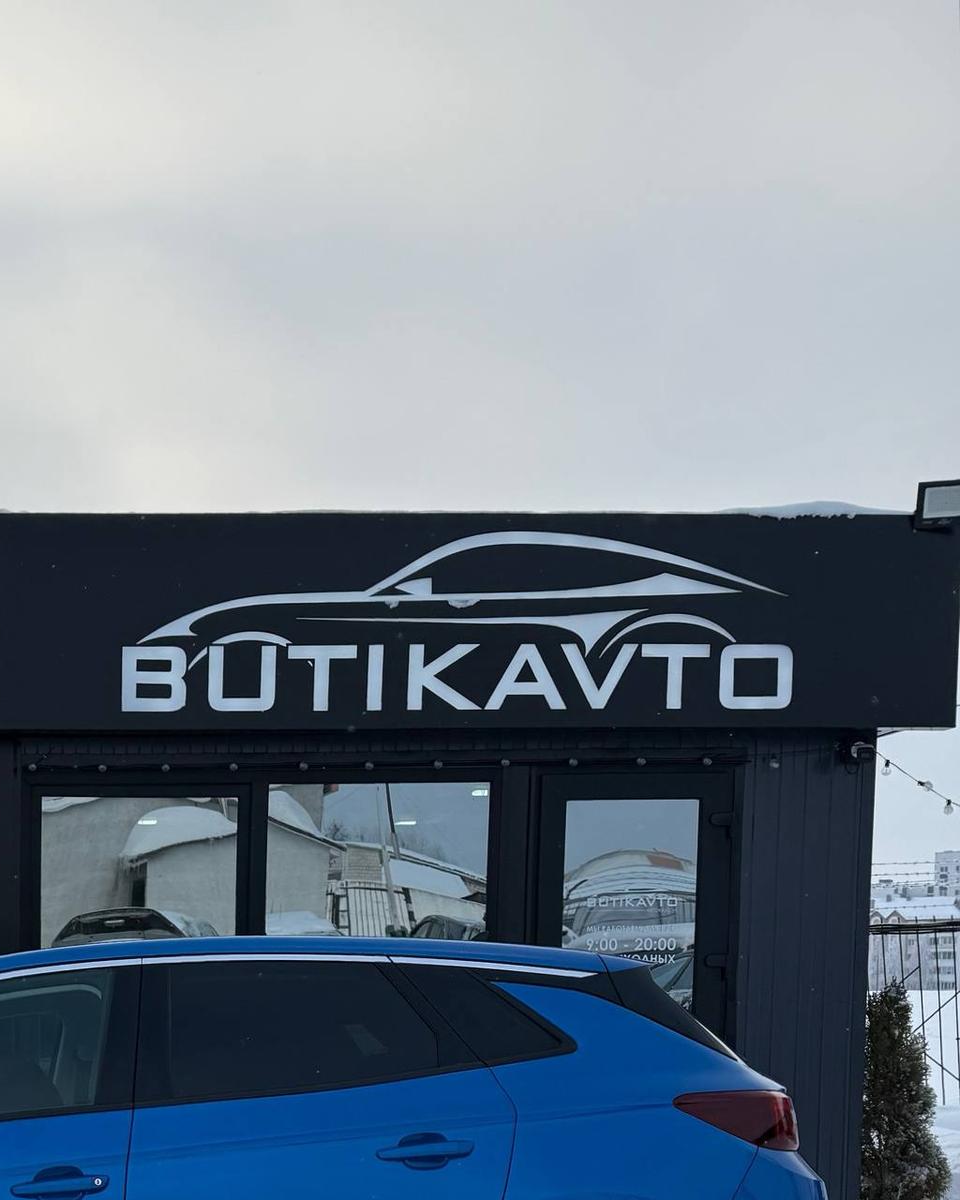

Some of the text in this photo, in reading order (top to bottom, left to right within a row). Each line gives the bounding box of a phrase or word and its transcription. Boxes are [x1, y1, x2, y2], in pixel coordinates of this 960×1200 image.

[121, 643, 794, 712] BUTIKAVTO
[587, 897, 678, 907] BUTIKAVTO
[586, 938, 618, 951] 9:00
[634, 938, 677, 951] 20:00
